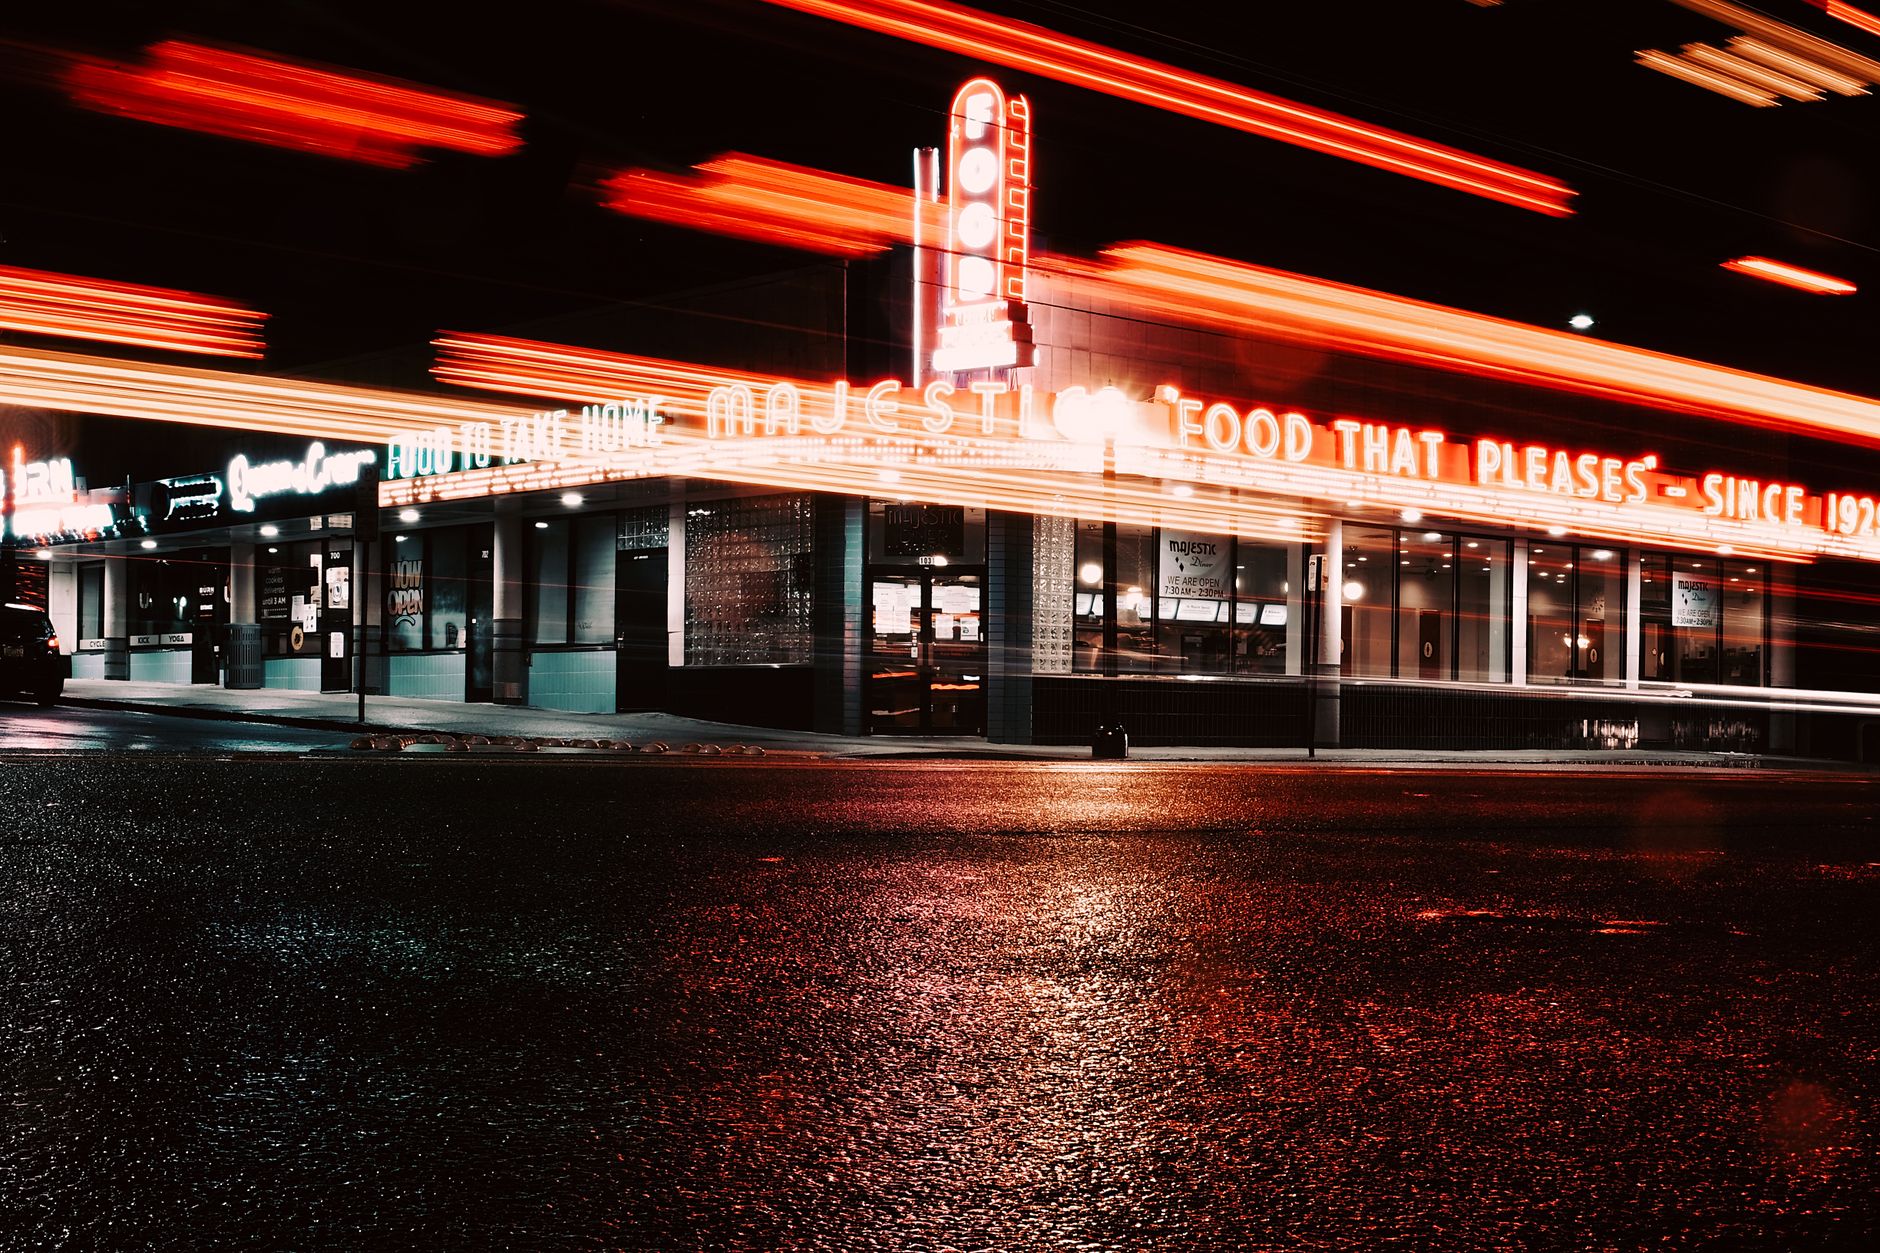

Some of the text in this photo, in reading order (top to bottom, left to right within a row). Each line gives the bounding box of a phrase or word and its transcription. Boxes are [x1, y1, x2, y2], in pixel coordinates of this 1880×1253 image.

[707, 379, 1094, 442] MAJESTIC
[460, 421, 490, 470] TO
[500, 409, 568, 465] TAKE
[581, 397, 666, 452] HOME
[1334, 419, 1445, 478] THAT
[1703, 473, 1805, 526] SINCE
[1828, 492, 1880, 537] 192
[888, 509, 961, 529] MAJESTIC
[330, 552, 341, 560] 700
[1169, 540, 1216, 556] MAJESTIC
[1190, 556, 1213, 567] Diner
[390, 560, 423, 589] NOW
[1167, 575, 1220, 587] WE ARE OPEN
[1678, 580, 1709, 592] MAJESTIC
[387, 588, 424, 616] OPEN
[168, 635, 185, 643] YOGA
